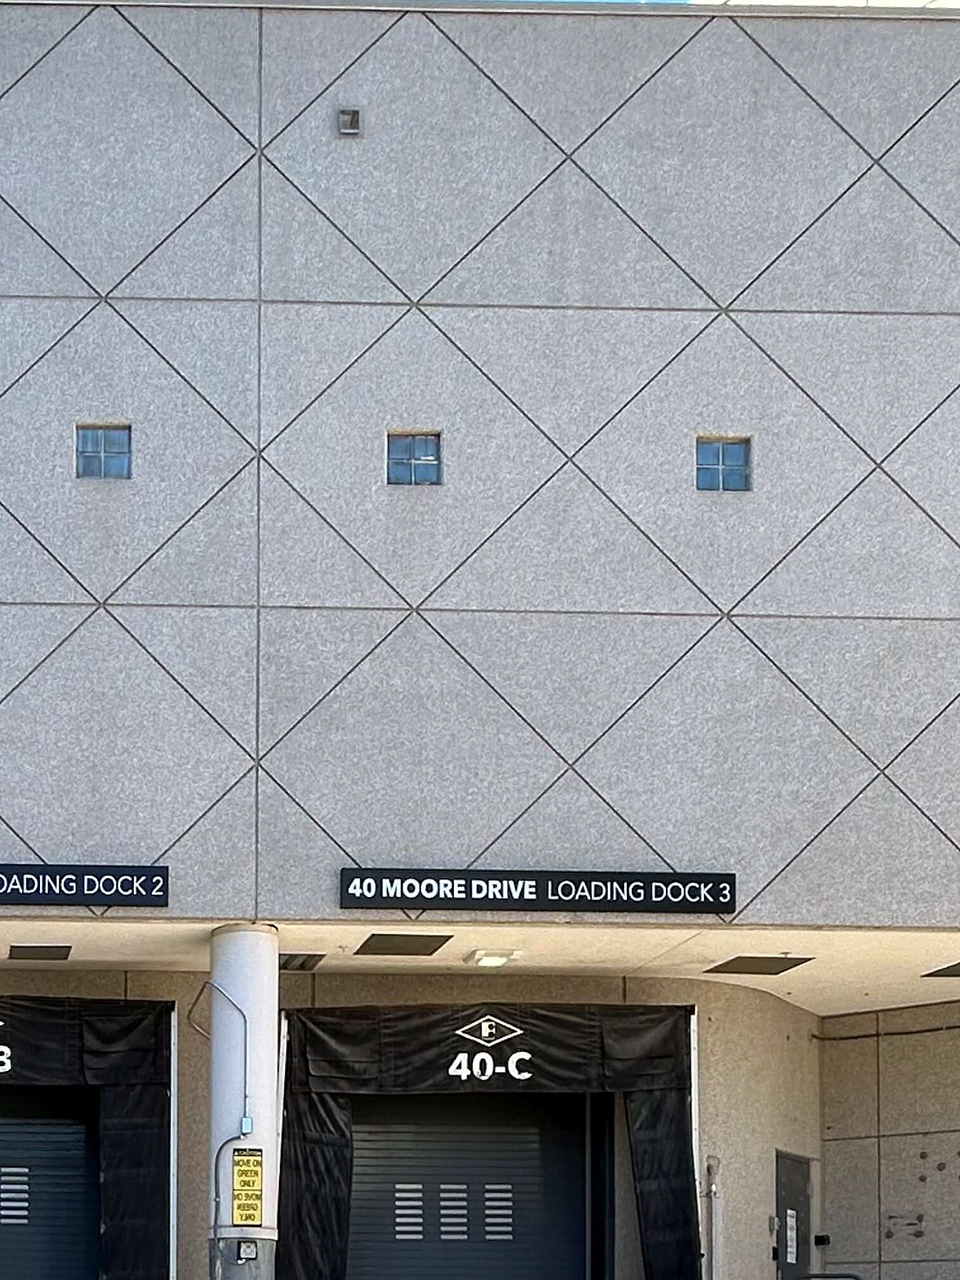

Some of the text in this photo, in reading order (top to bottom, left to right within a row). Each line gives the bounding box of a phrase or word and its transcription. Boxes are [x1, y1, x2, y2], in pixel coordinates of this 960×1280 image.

[84, 876, 146, 895] DOCK
[152, 876, 163, 895] 2
[348, 878, 730, 902] 40 MOORE DRIVE LOADING DOCK 3
[449, 1052, 533, 1081] 40-C
[237, 1169, 258, 1177] GREEN
